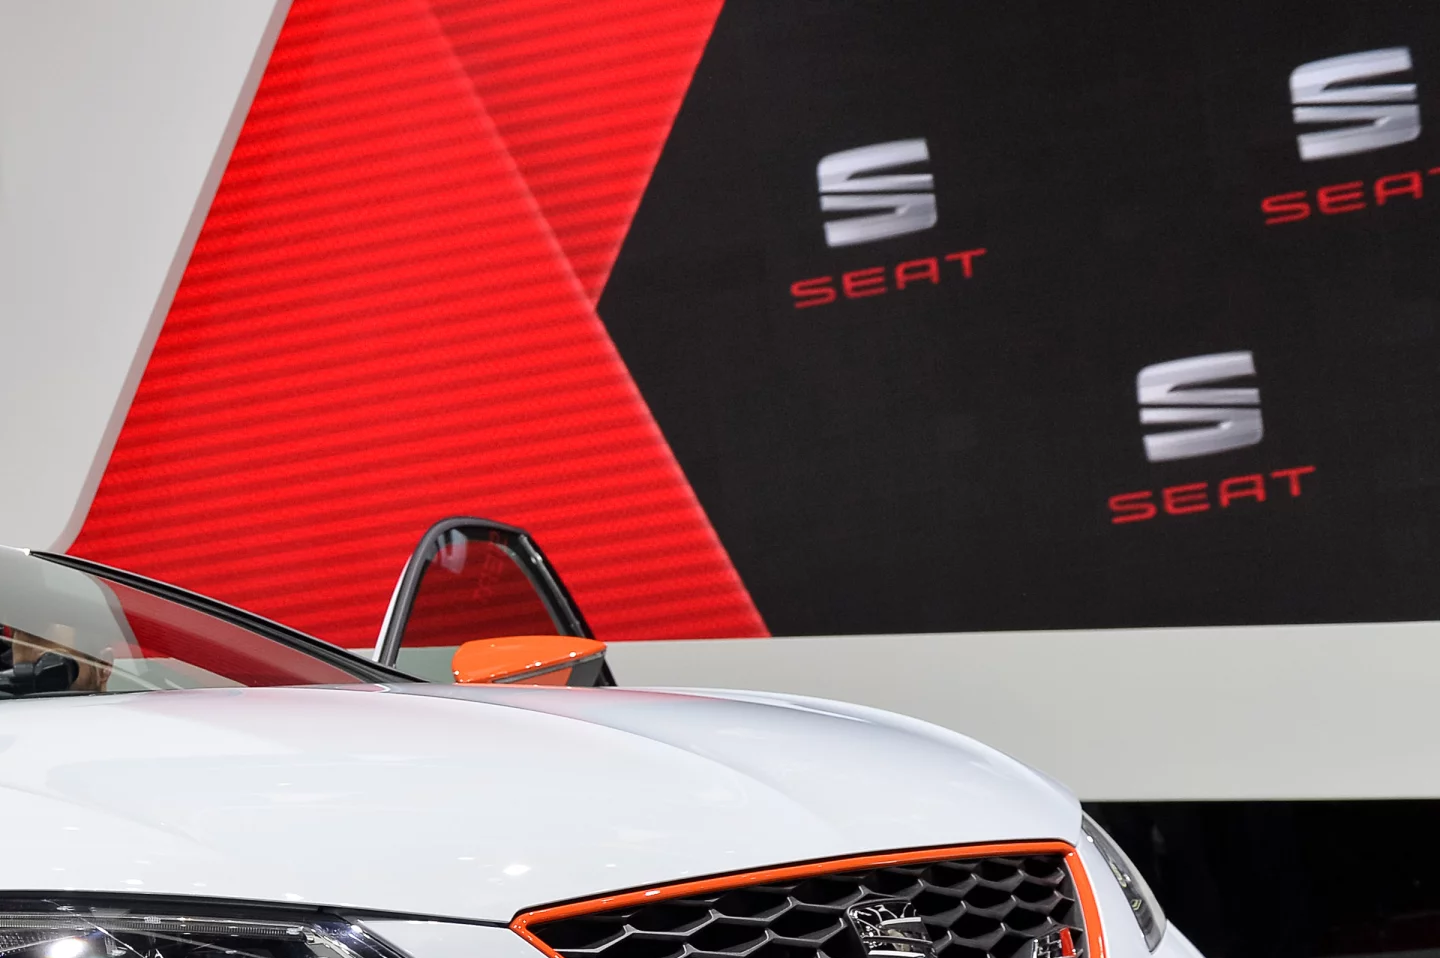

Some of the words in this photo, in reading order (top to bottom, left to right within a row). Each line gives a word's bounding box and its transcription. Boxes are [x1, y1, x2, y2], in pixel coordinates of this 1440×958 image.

[1261, 166, 1440, 225] SEA
[790, 247, 987, 309] SEAT
[1109, 466, 1316, 525] SEAT
